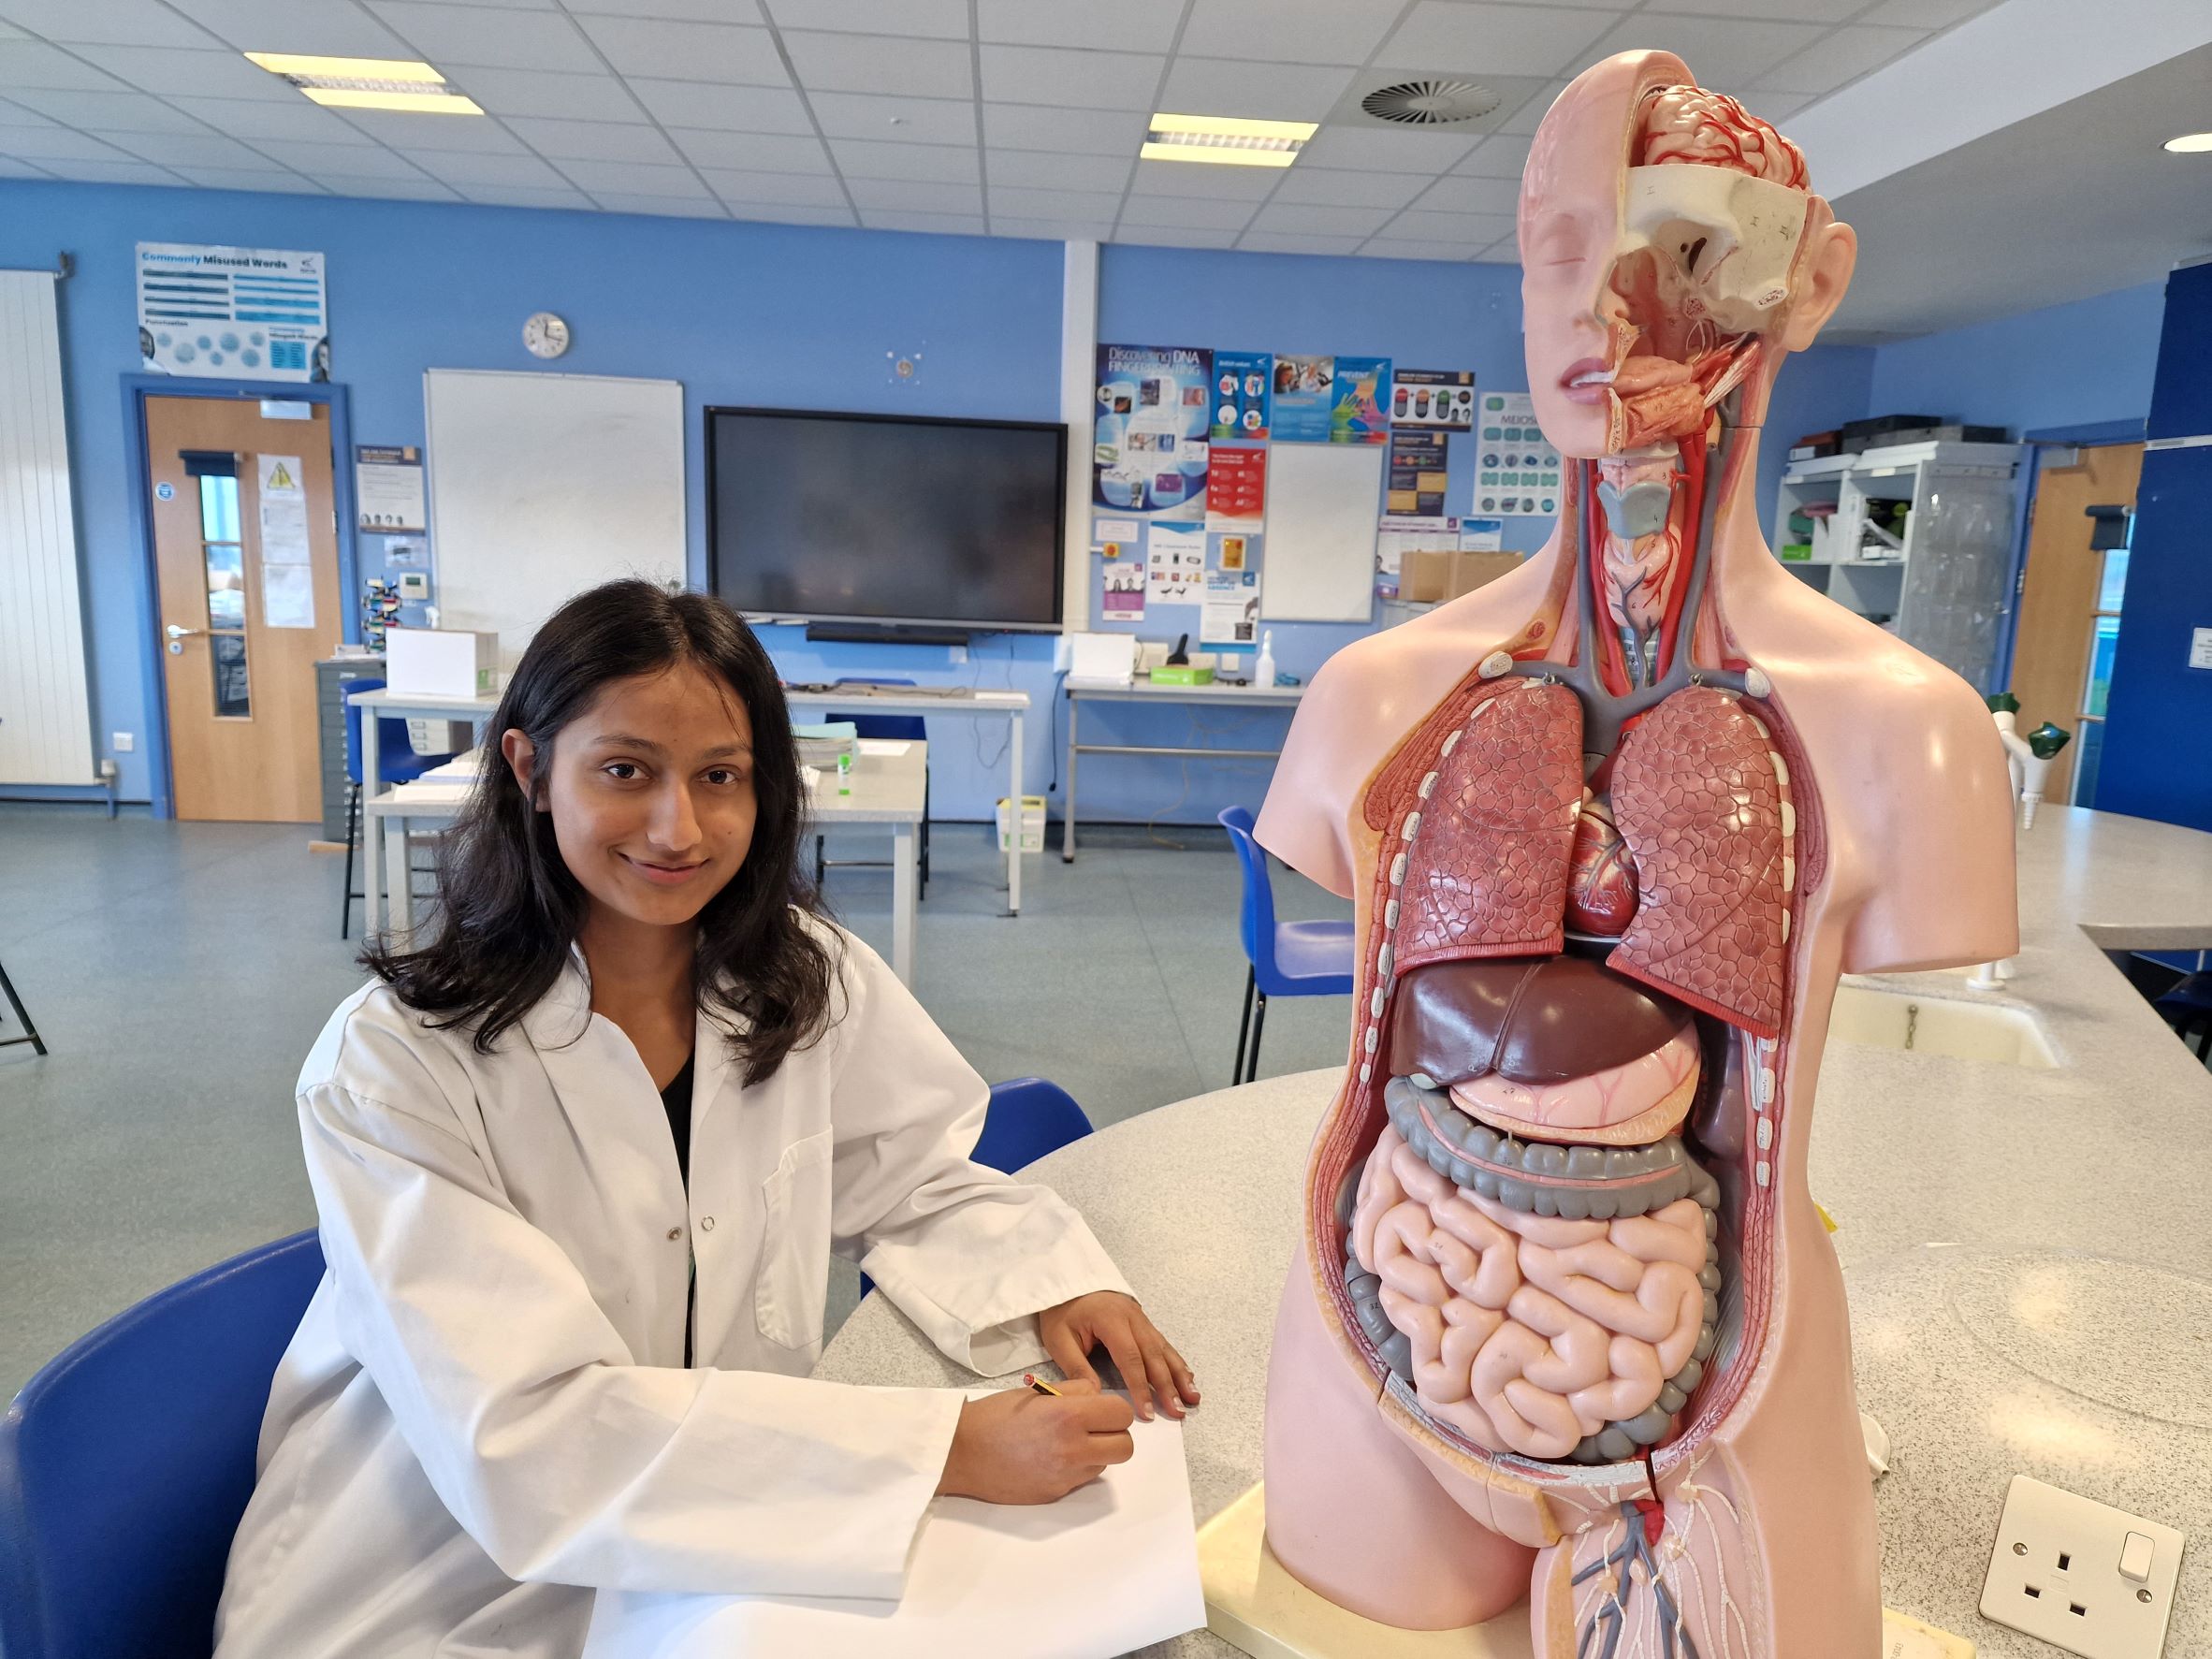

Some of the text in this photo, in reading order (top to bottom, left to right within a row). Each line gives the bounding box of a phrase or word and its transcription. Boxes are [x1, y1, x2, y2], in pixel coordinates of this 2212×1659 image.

[141, 252, 288, 269] Commonly Misused Words
[1108, 346, 1201, 367] Discovering DNA
[1108, 361, 1201, 375] FINGERPRINTING
[1337, 370, 1371, 379] PREVENT
